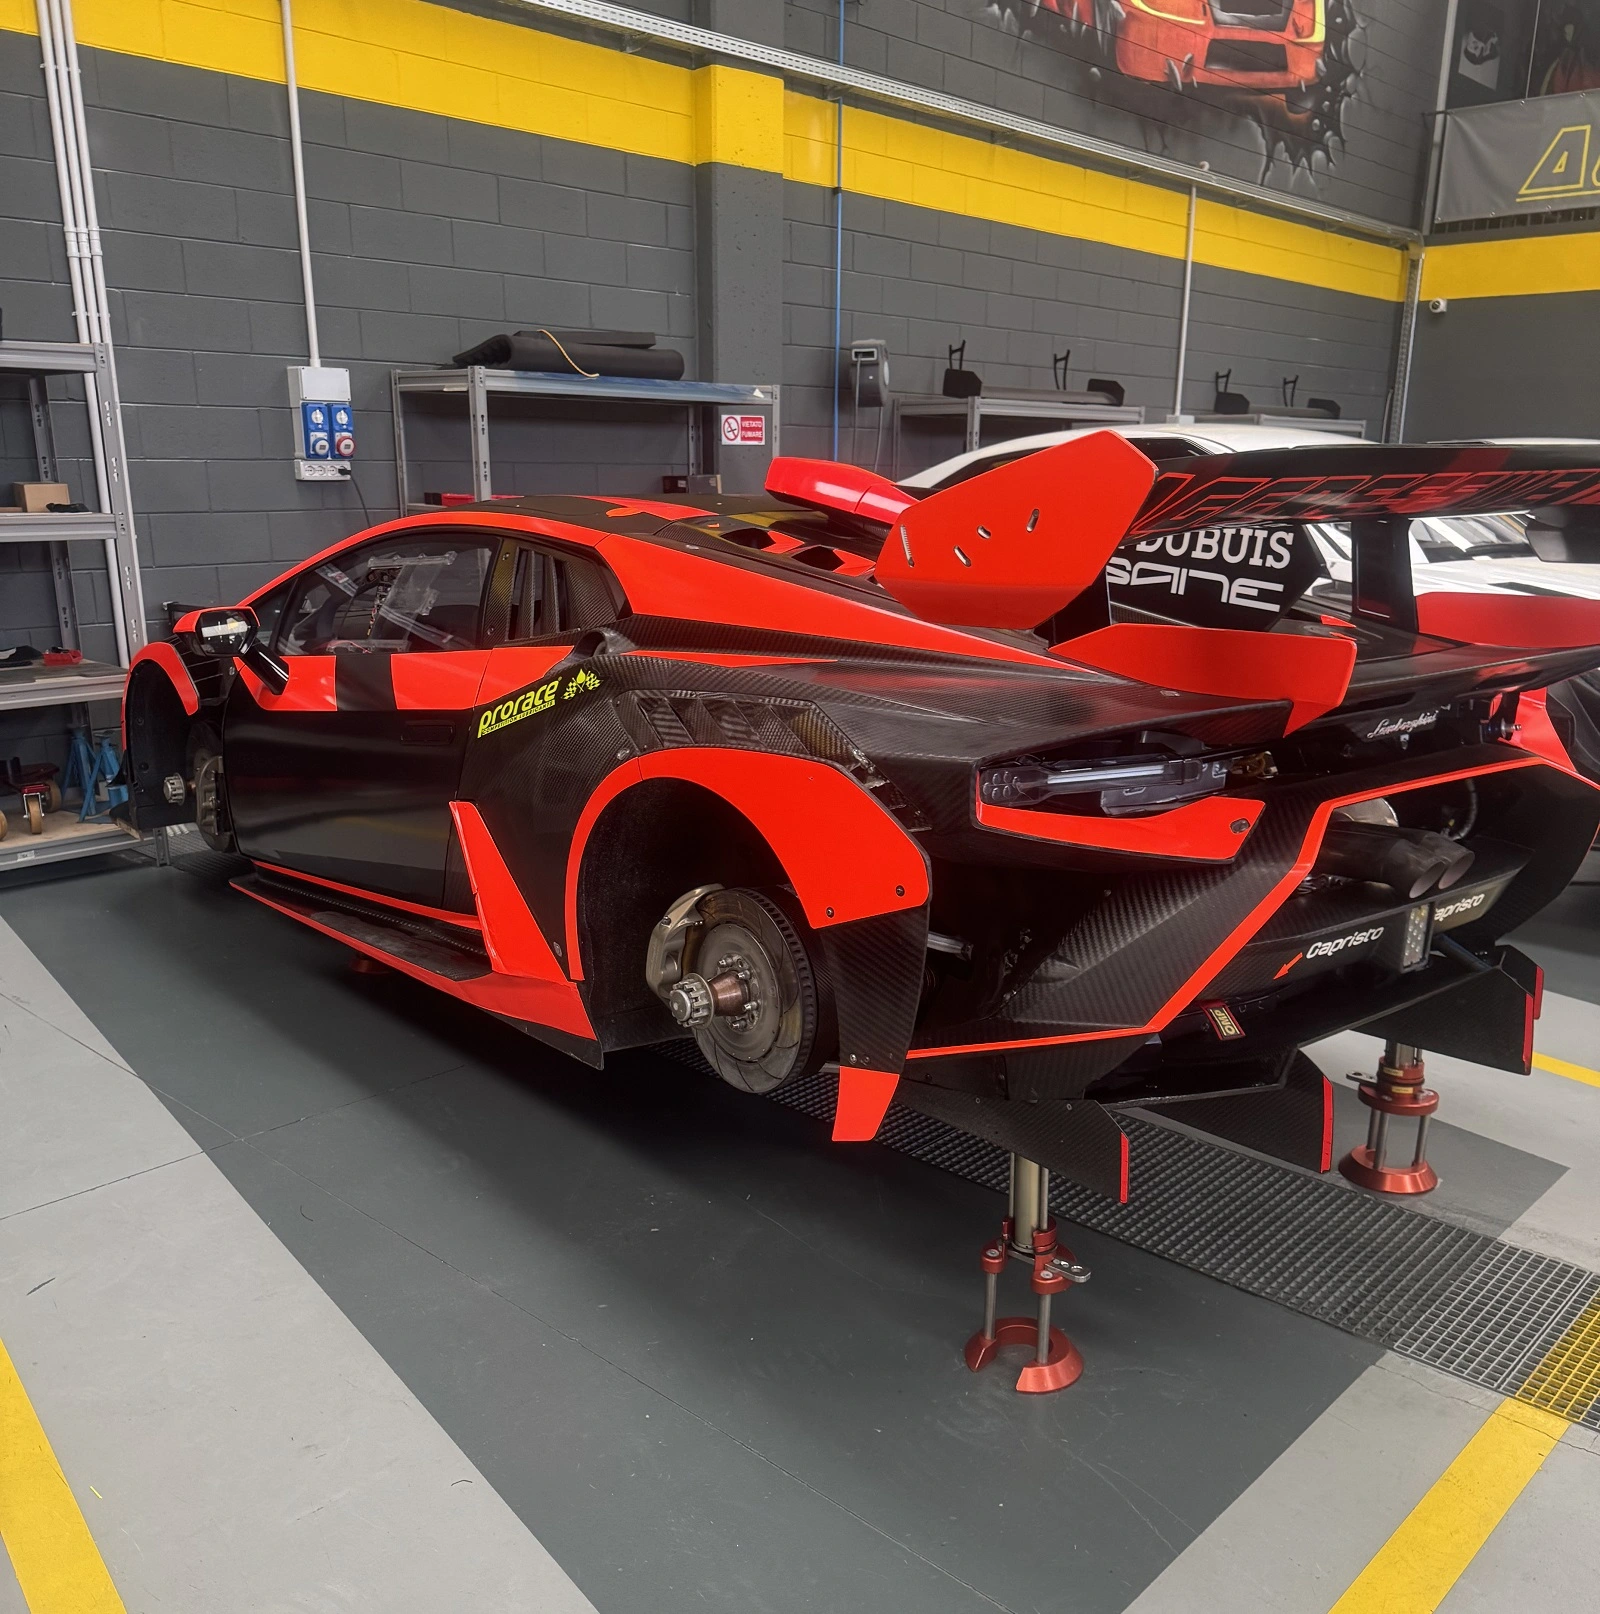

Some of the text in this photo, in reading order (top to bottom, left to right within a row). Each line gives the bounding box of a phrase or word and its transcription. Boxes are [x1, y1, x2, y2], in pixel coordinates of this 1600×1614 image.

[1518, 124, 1600, 195] A
[477, 680, 559, 738] prorace
[1434, 893, 1485, 921] apristo
[1306, 927, 1384, 959] Capristo
[1214, 1009, 1235, 1035] OMP
